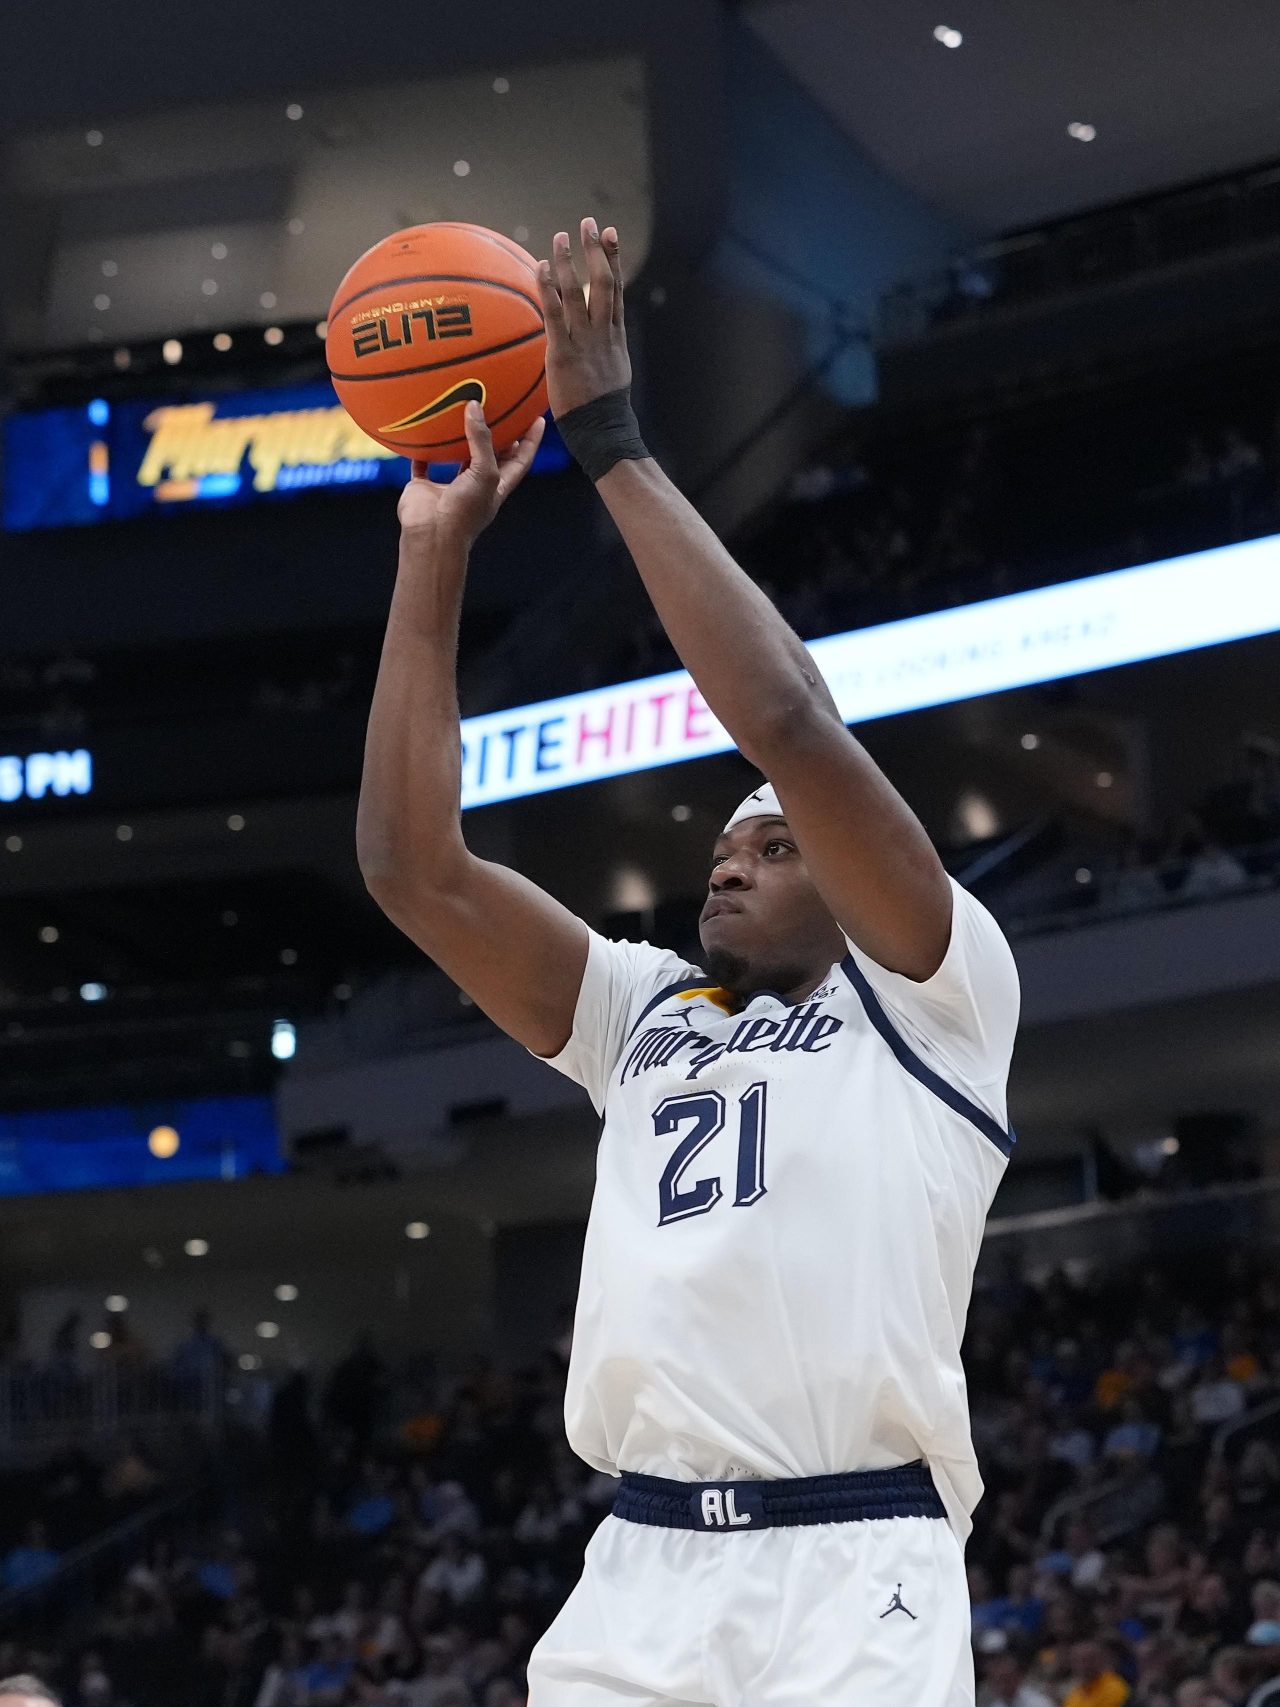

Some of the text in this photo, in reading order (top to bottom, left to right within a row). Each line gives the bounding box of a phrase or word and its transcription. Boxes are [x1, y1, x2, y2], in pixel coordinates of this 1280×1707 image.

[351, 303, 473, 359] ELITE
[462, 687, 712, 789] ITEHITE
[25, 748, 92, 799] PM
[651, 1081, 768, 1228] 21
[701, 1488, 752, 1526] AL
